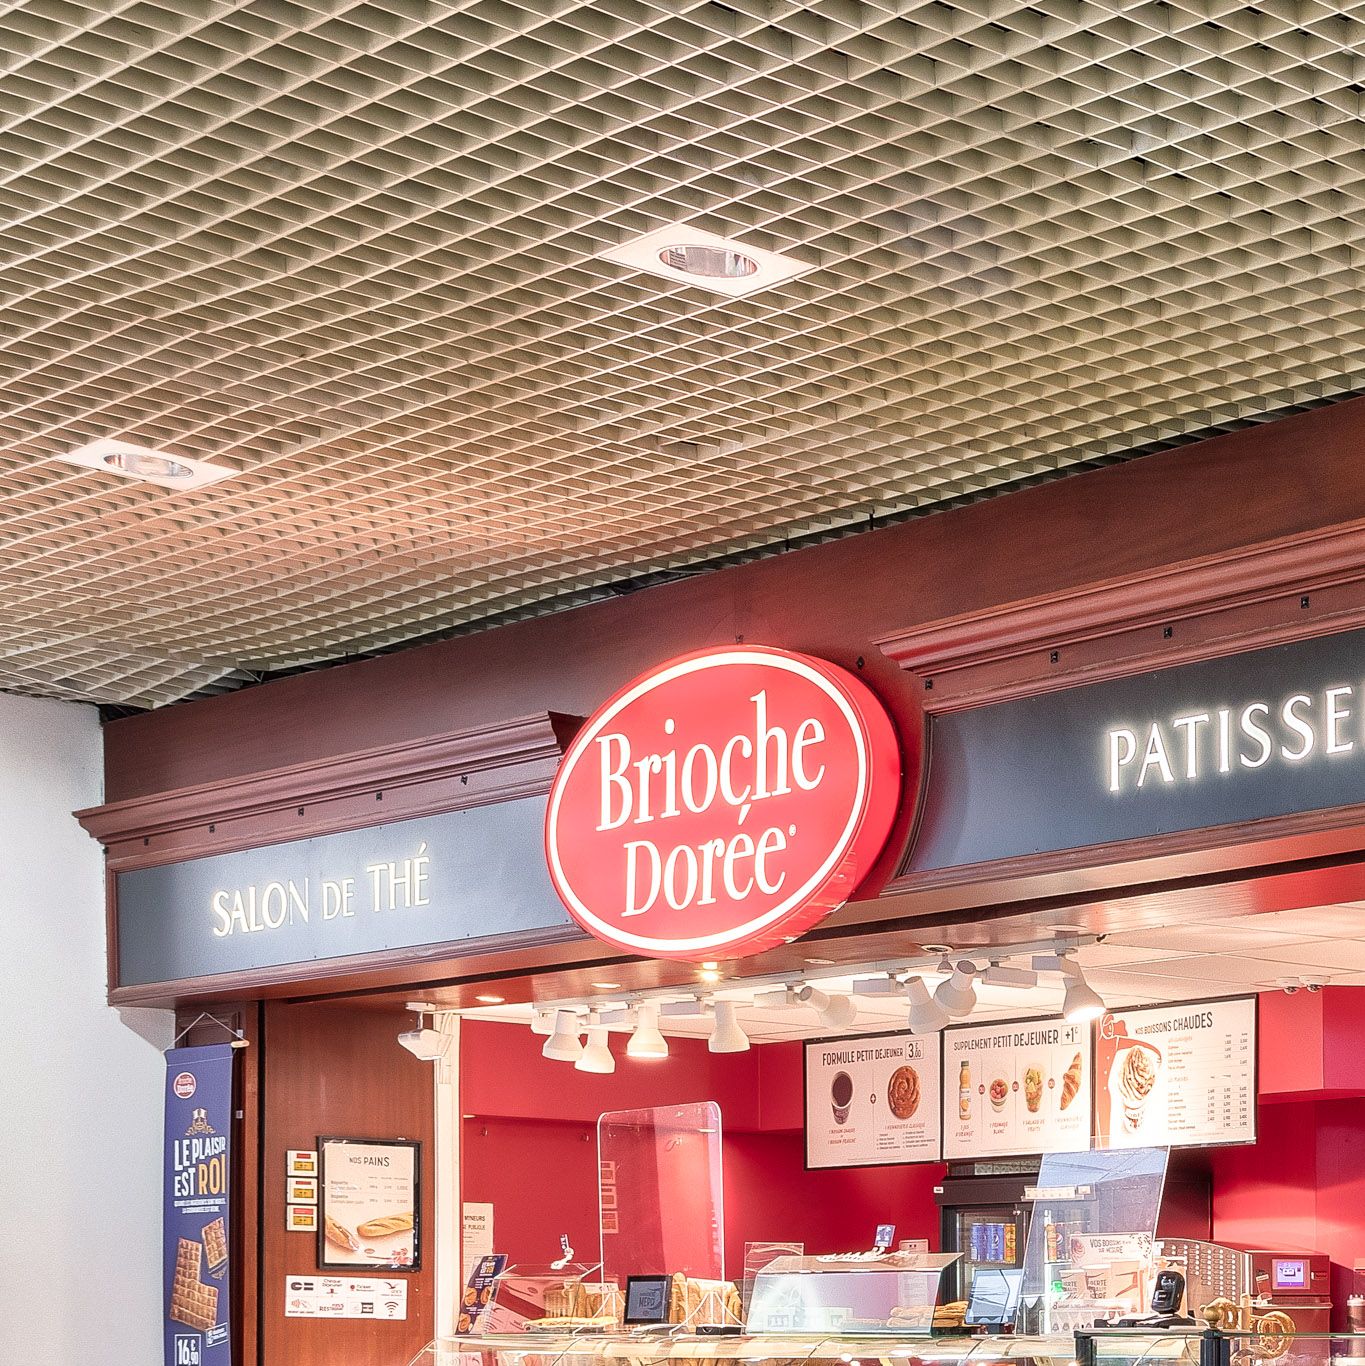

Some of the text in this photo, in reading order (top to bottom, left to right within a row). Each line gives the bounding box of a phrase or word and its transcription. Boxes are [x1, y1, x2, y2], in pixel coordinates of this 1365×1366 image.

[595, 689, 826, 832] Brioche
[211, 843, 431, 938] SALON DE THÉ
[1144, 1020, 1172, 1035] BOISSONS
[1173, 1011, 1213, 1032] CHAUDES
[953, 1037, 992, 1051] SUPPLEMENT
[993, 1034, 1013, 1049] PETIT
[822, 1050, 855, 1067] FORMULE
[856, 1049, 874, 1062] PETIT
[174, 1136, 226, 1171] LE PLAISIR
[363, 1156, 390, 1167] PAINS
[174, 1153, 227, 1197] EST ROI
